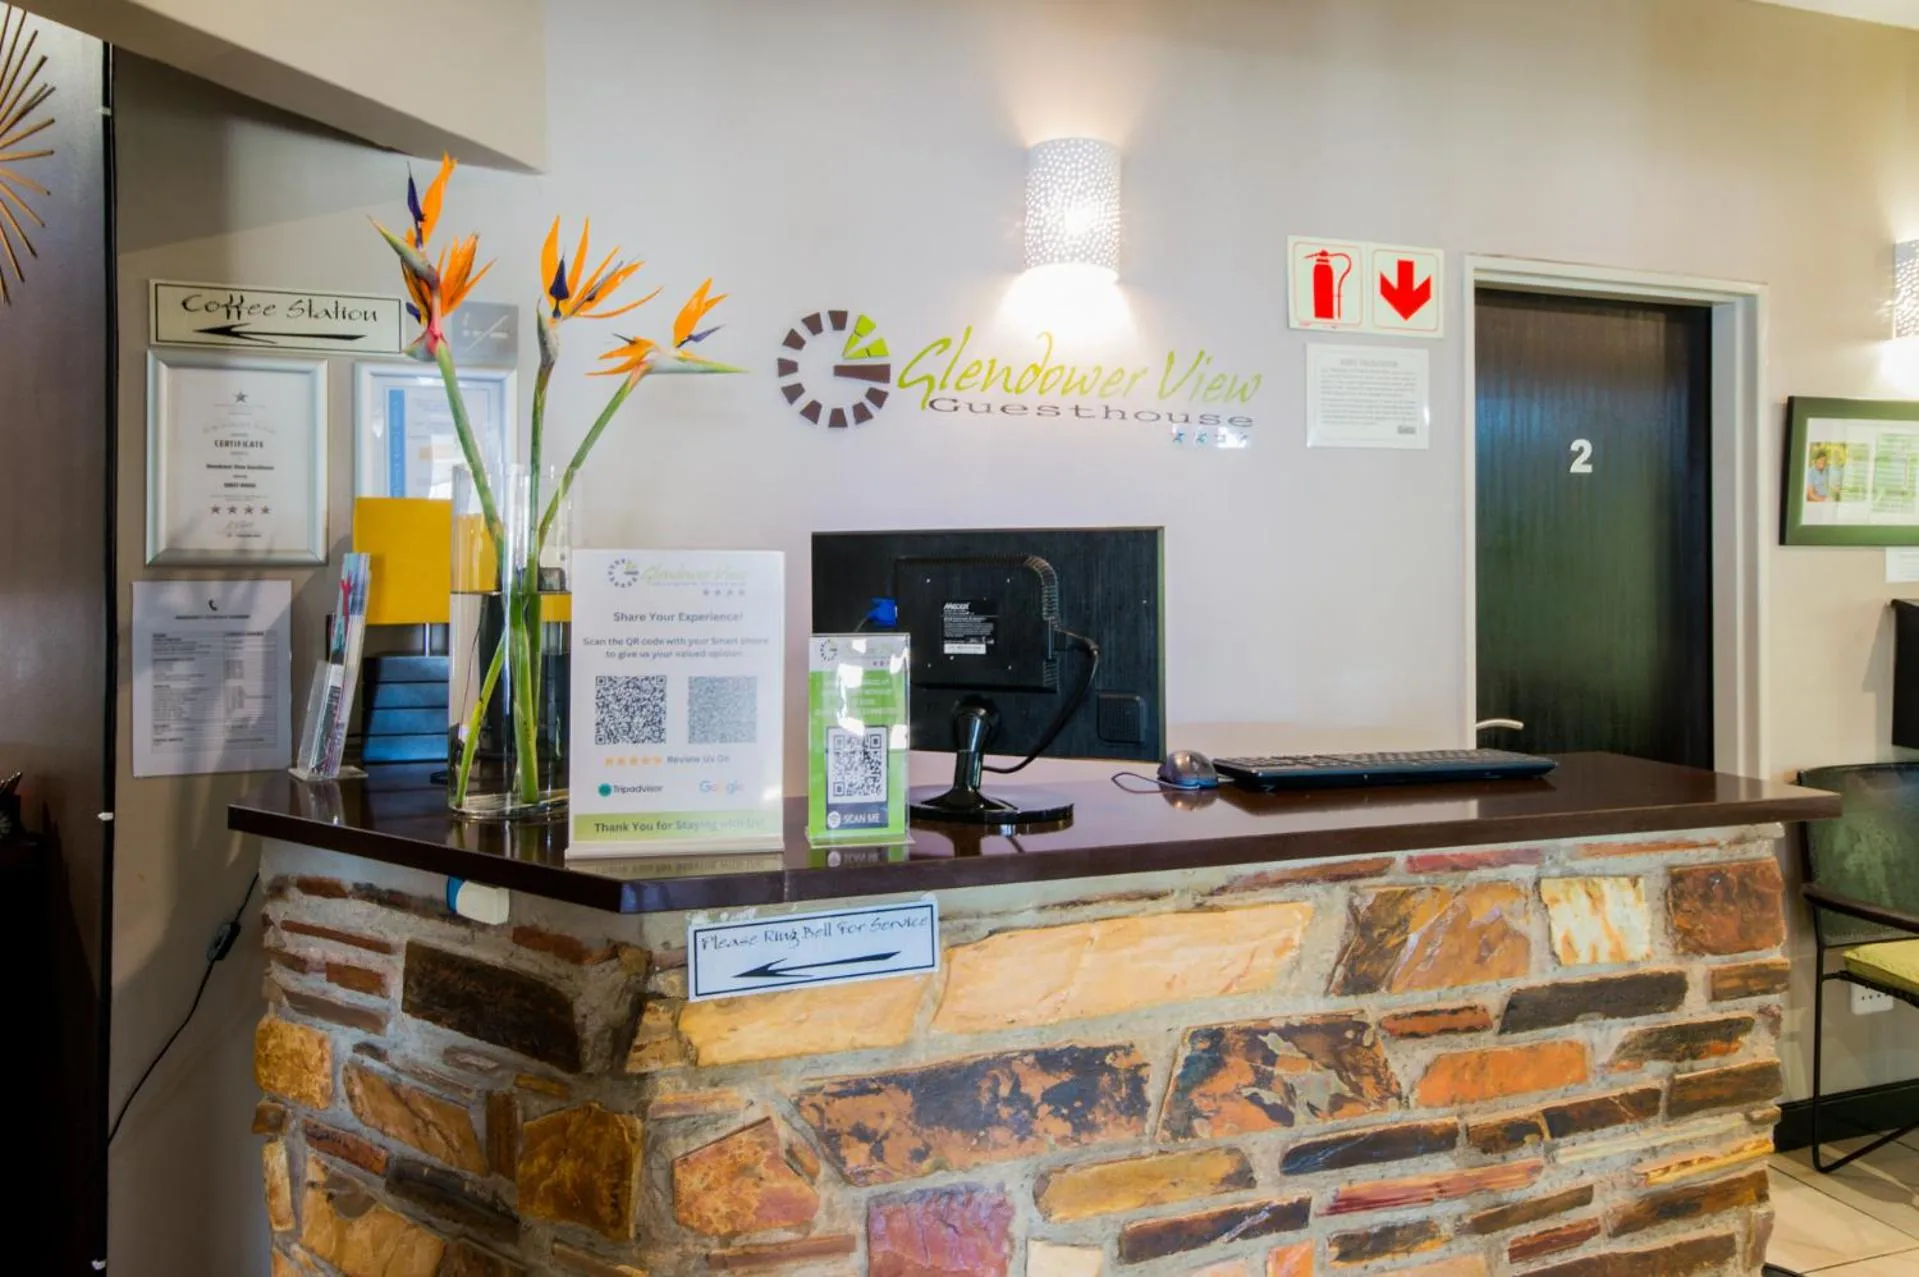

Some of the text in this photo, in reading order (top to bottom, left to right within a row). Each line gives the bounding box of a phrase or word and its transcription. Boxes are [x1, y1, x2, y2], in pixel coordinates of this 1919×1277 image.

[181, 294, 377, 323] Coffee Station
[897, 324, 1149, 412] Glendower
[1158, 348, 1263, 403] View
[928, 397, 1254, 428] Guesthouse
[1570, 439, 1593, 473] 2
[613, 610, 744, 625] Share Your Experience!
[583, 637, 607, 646] Scan
[608, 636, 624, 646] the
[626, 636, 640, 646] QR
[641, 637, 665, 646] code
[666, 636, 686, 646] with
[688, 637, 710, 648] your
[606, 649, 617, 659] to
[618, 649, 642, 661] give
[643, 650, 651, 658] us
[652, 650, 674, 661] your
[675, 648, 706, 658] valued
[667, 754, 731, 764] Review Us On
[613, 780, 745, 795] Tripadvisor Google
[594, 821, 629, 833] Thank
[632, 821, 654, 832] You
[656, 820, 673, 831] for
[676, 818, 718, 833] Staying
[843, 813, 880, 825] SCAN ME
[701, 916, 929, 951] Please Ring Bell For Service
